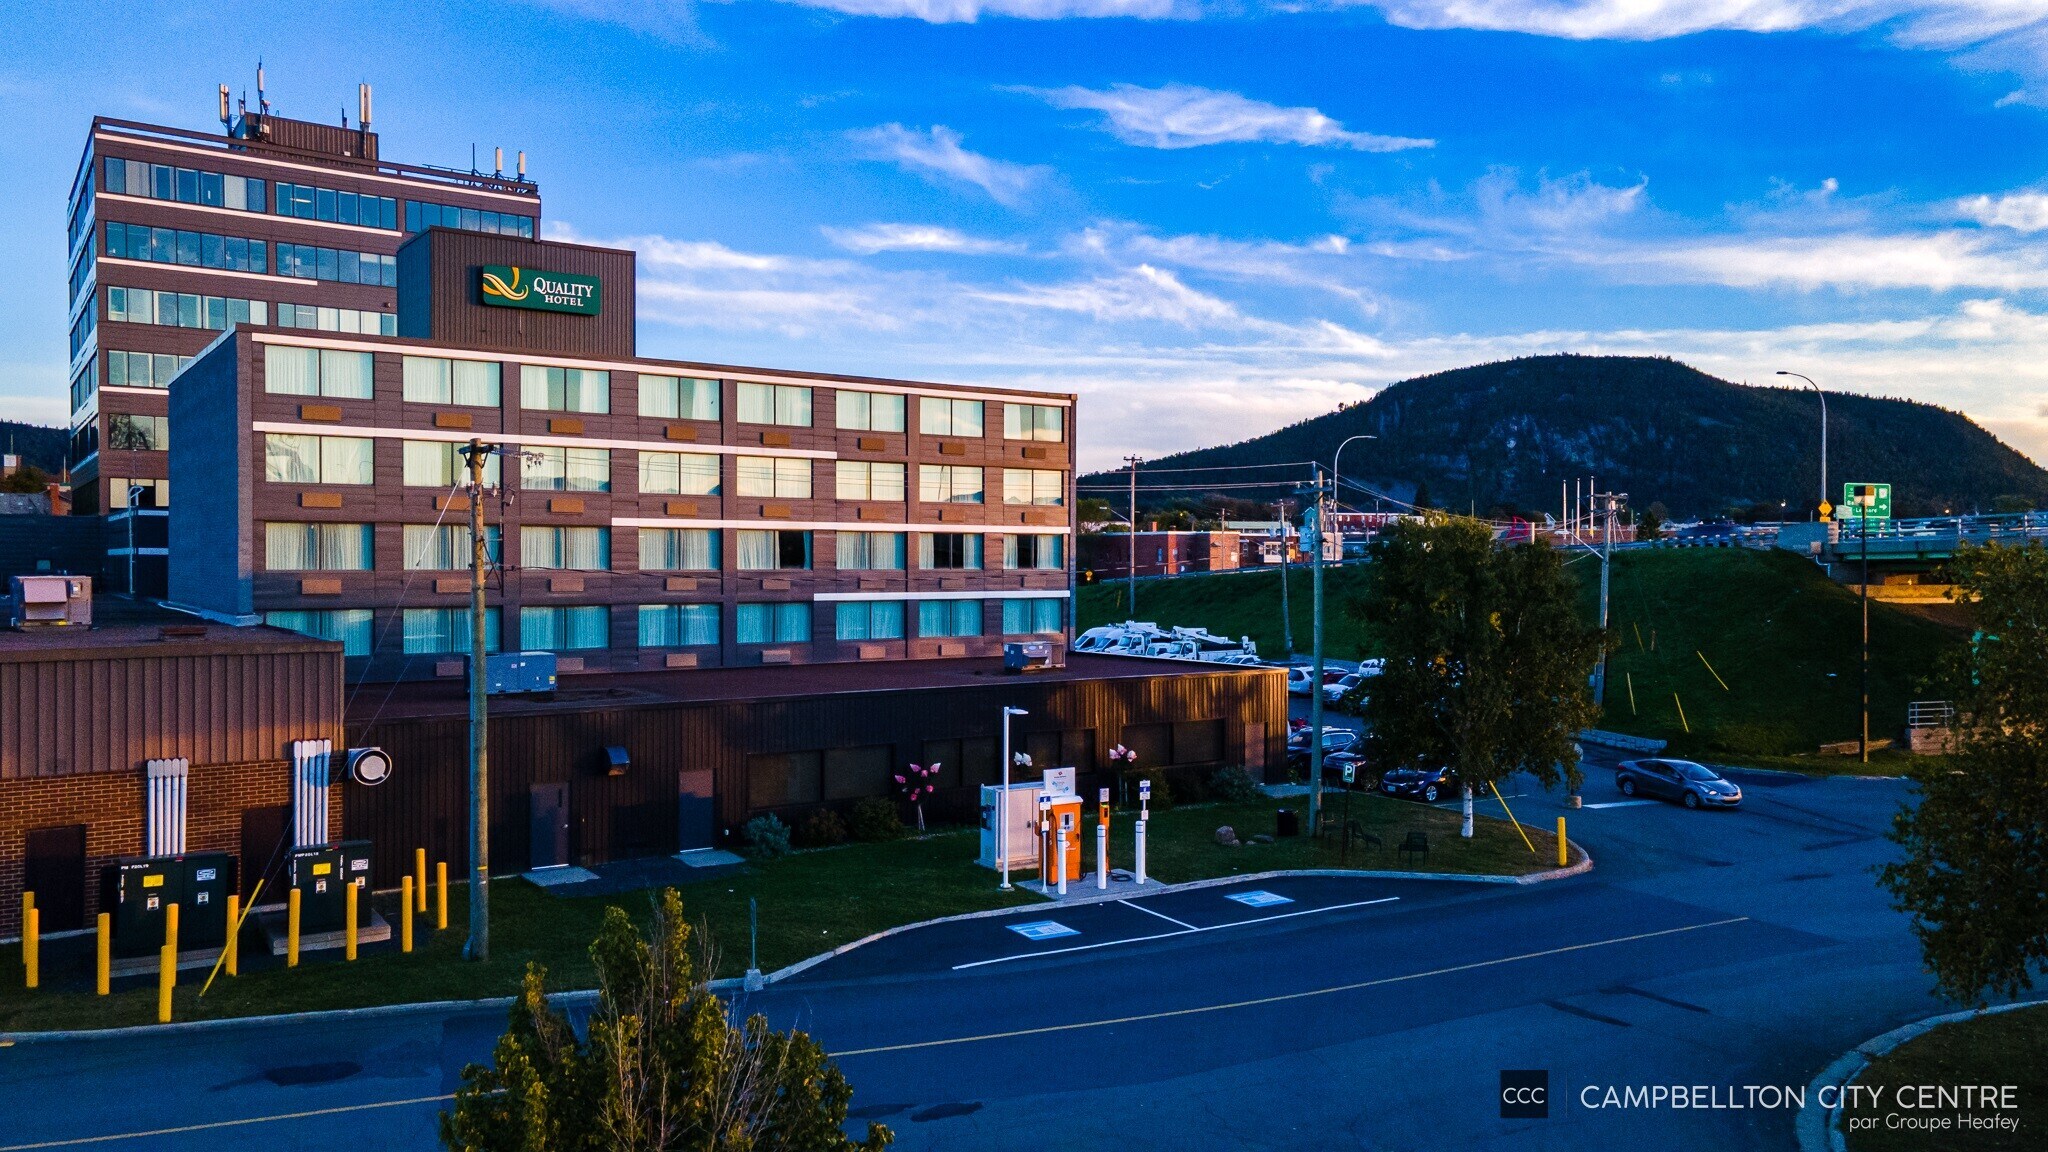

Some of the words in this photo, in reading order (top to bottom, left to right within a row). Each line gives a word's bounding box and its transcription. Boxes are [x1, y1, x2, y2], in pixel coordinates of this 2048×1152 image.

[533, 277, 594, 298] QUALITY
[544, 295, 584, 307] HOTEL
[1344, 764, 1353, 776] P
